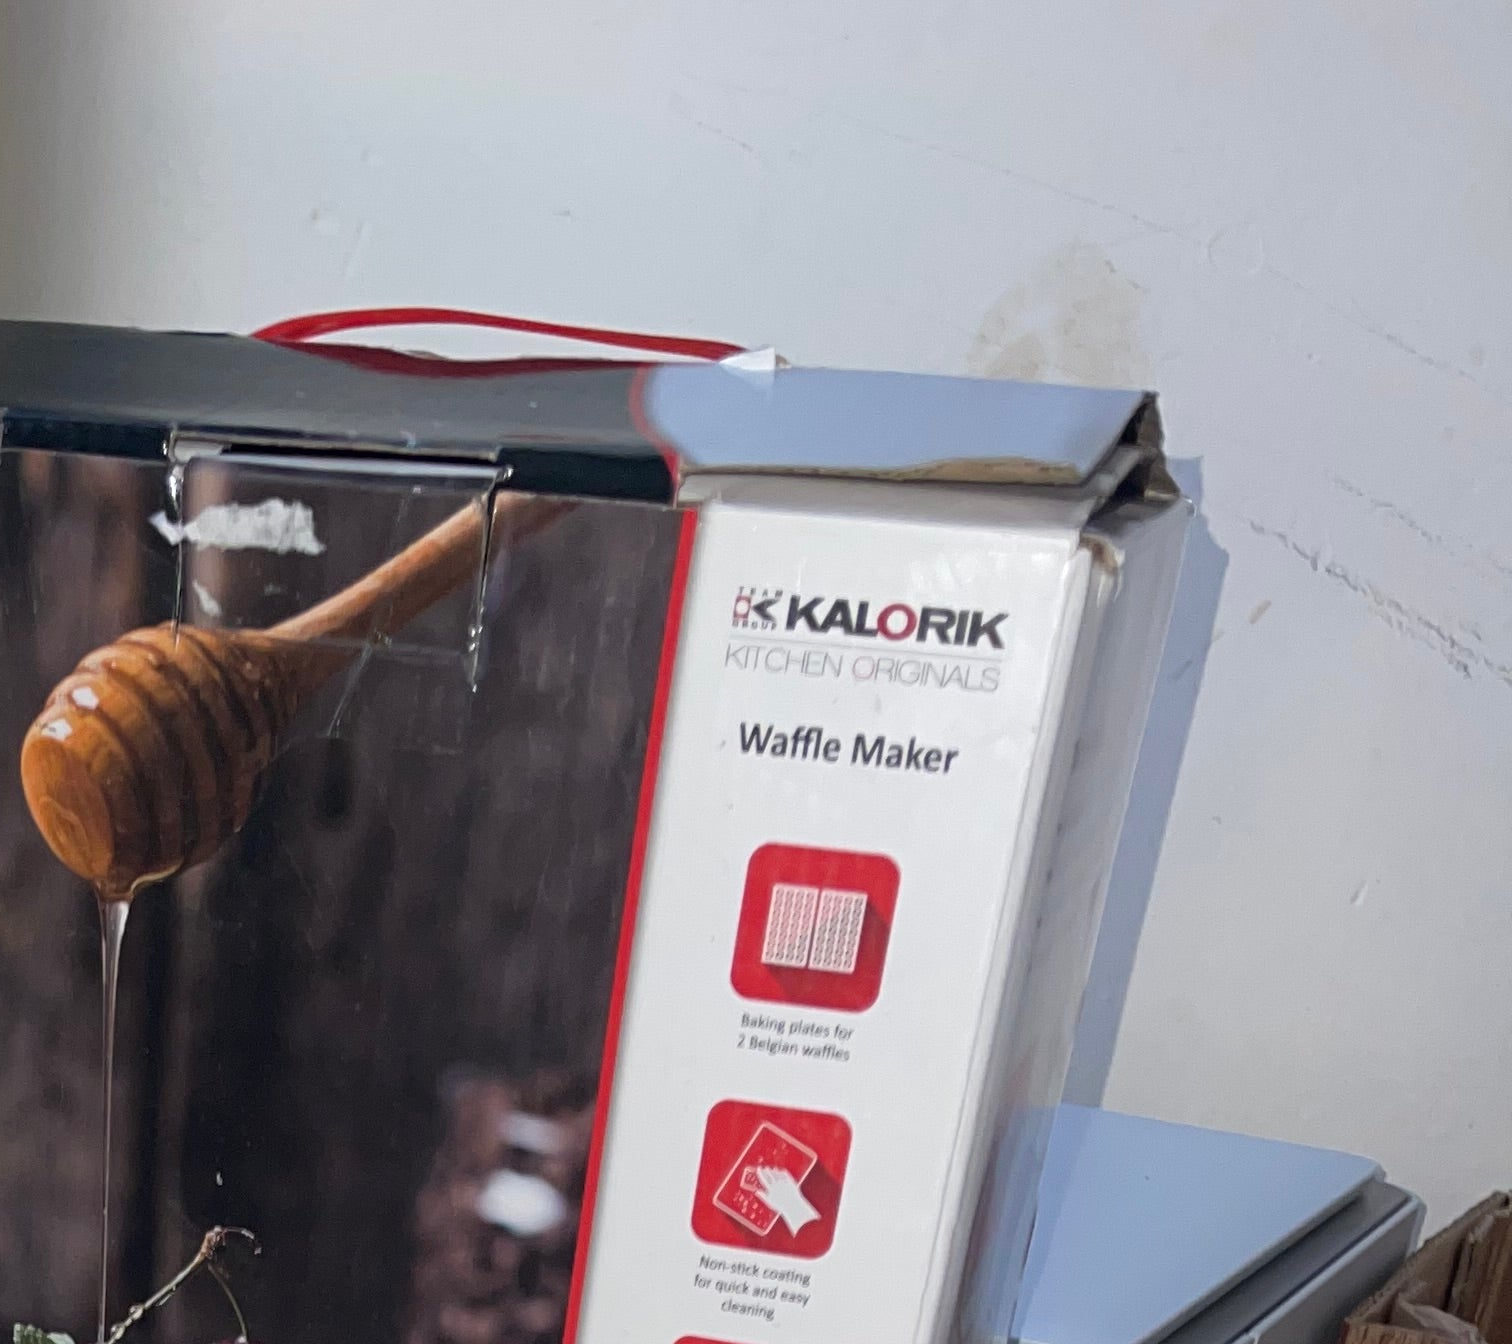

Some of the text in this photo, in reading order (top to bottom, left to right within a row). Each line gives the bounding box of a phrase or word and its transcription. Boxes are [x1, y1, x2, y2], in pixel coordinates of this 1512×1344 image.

[785, 594, 1009, 649] KALORIK
[724, 643, 1001, 693] KITCHEN ORIGINALS
[739, 721, 959, 774] Waffle Maker
[740, 1012, 854, 1041] Baking plates for
[737, 1033, 850, 1062] 2 Belgian waffles
[699, 1255, 811, 1287] Non-stick coating
[694, 1273, 811, 1308] for quick and easy
[720, 1299, 775, 1322] cleaning
